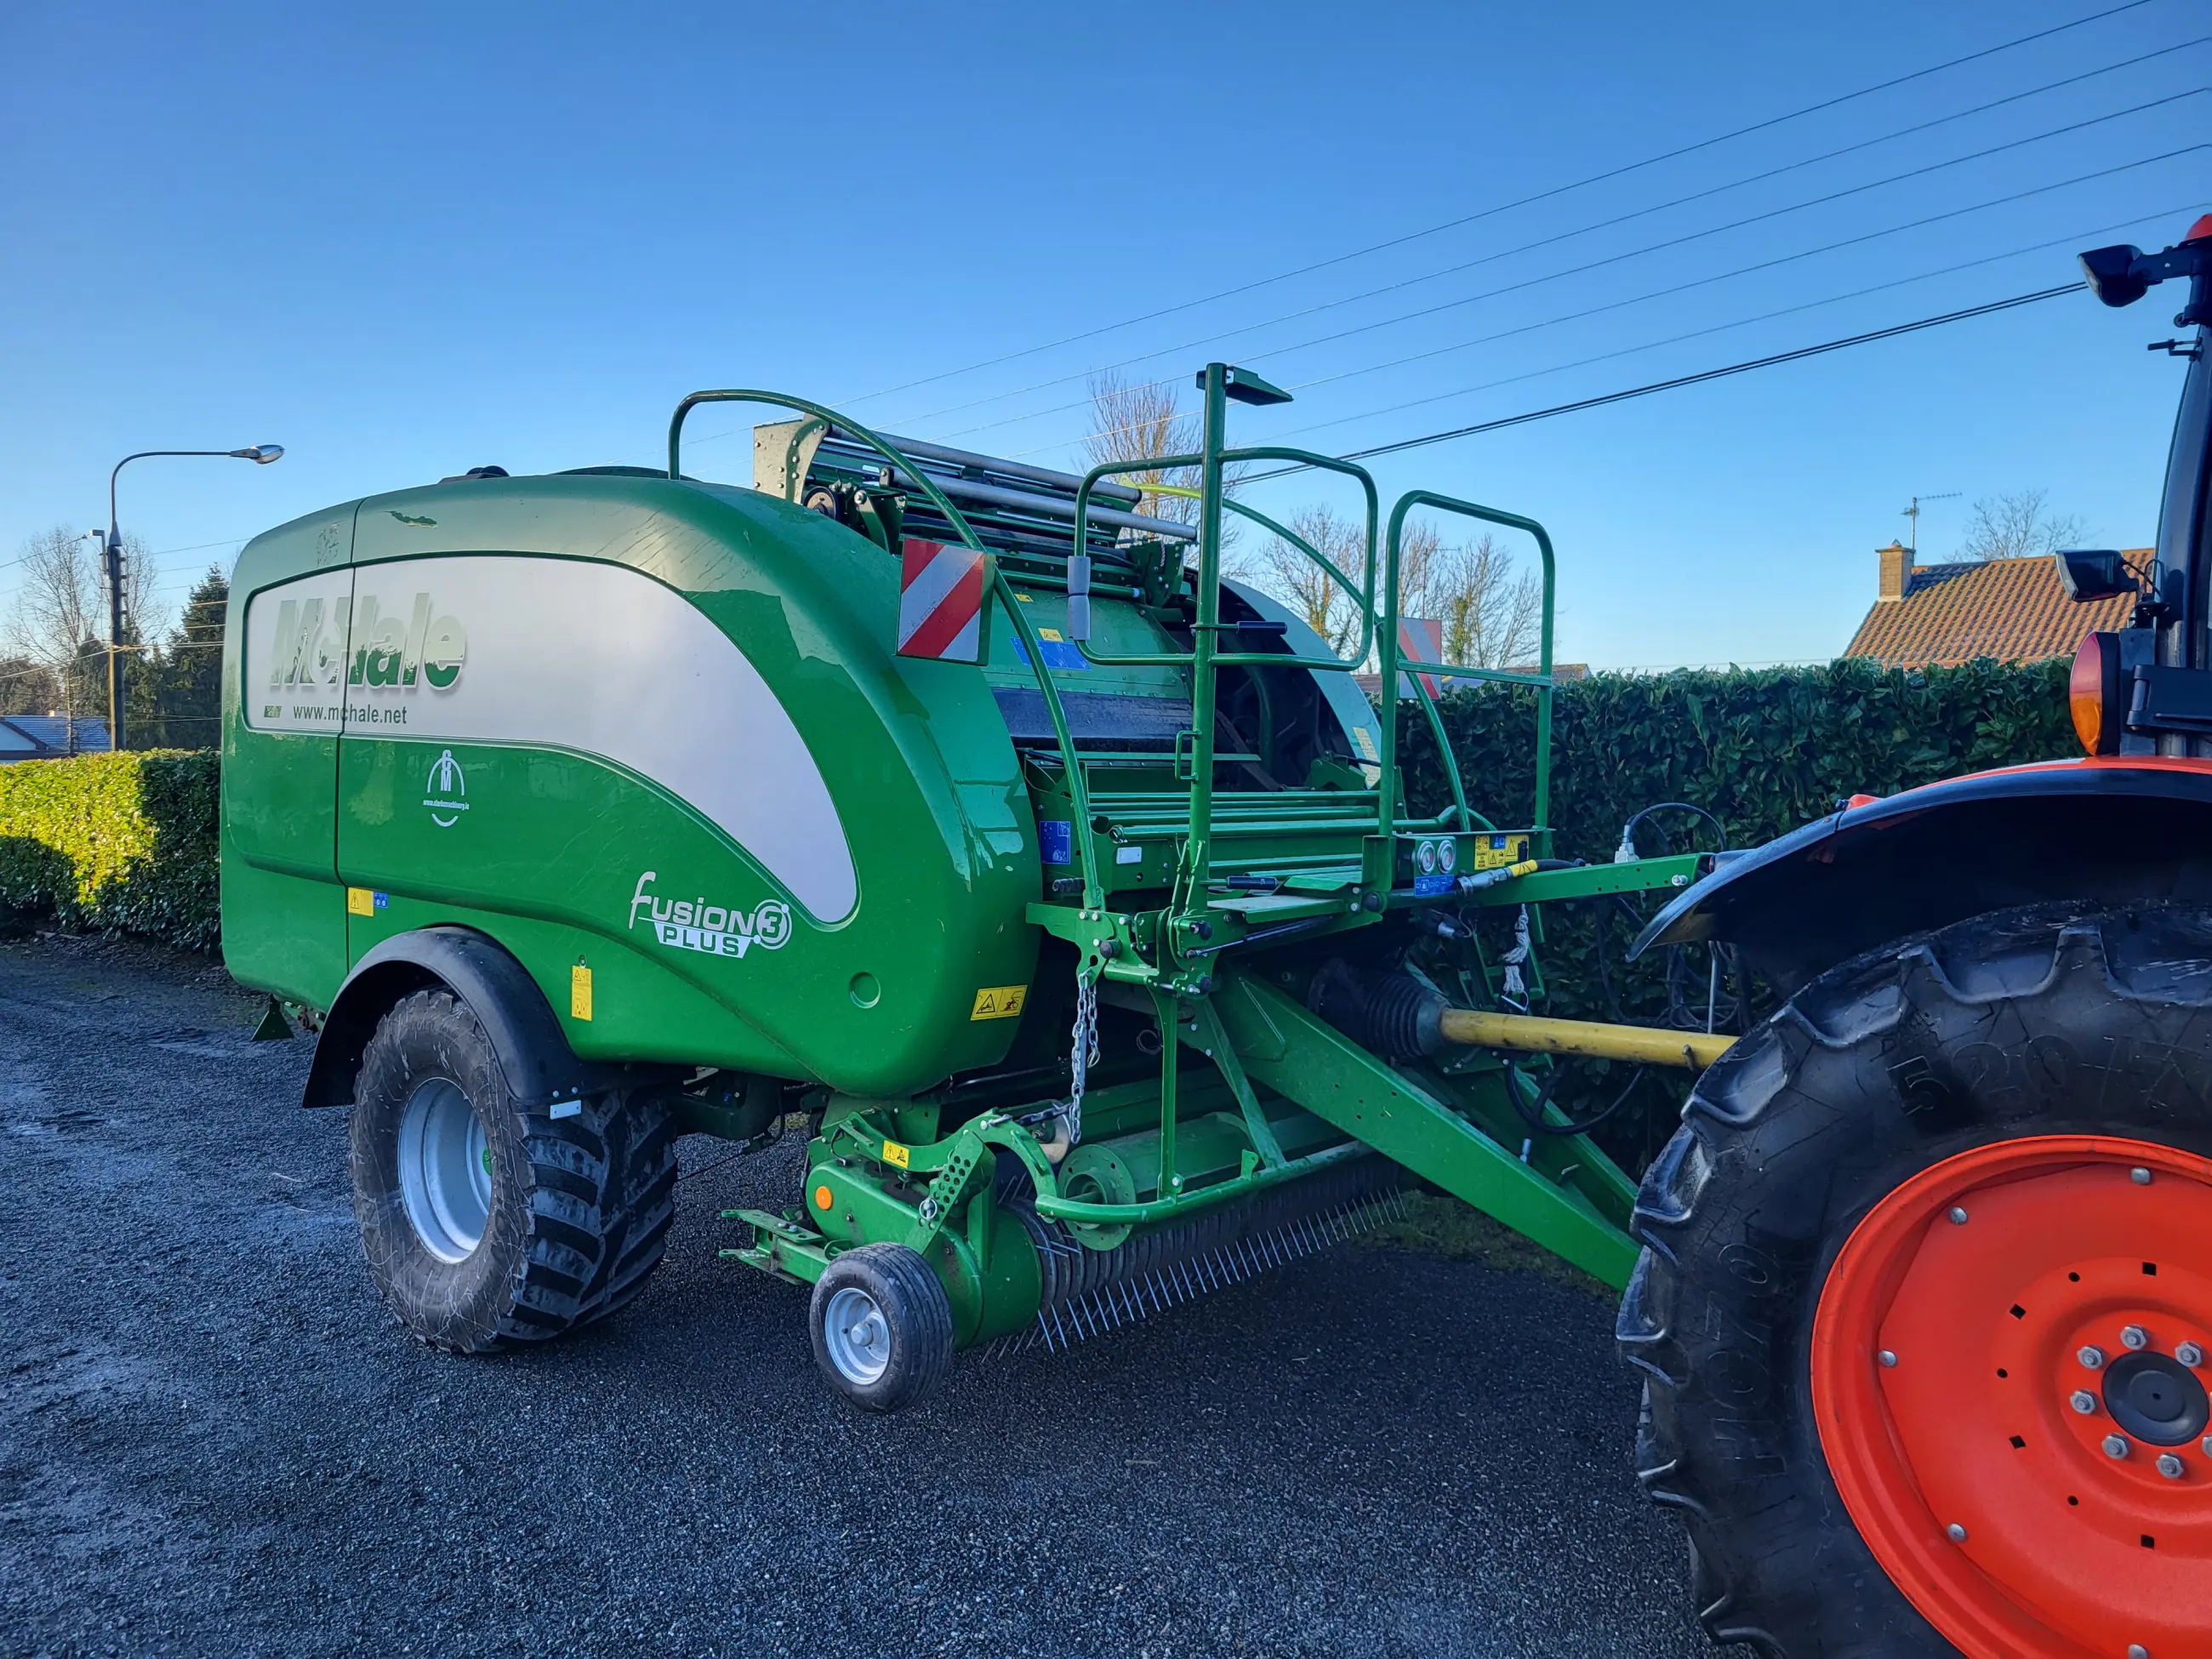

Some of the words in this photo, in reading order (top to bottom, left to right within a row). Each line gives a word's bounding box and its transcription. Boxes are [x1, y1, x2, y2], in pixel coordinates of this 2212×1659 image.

[269, 592, 465, 688] McHale
[293, 704, 408, 724] www.mchale.net
[662, 925, 739, 956] PLUS
